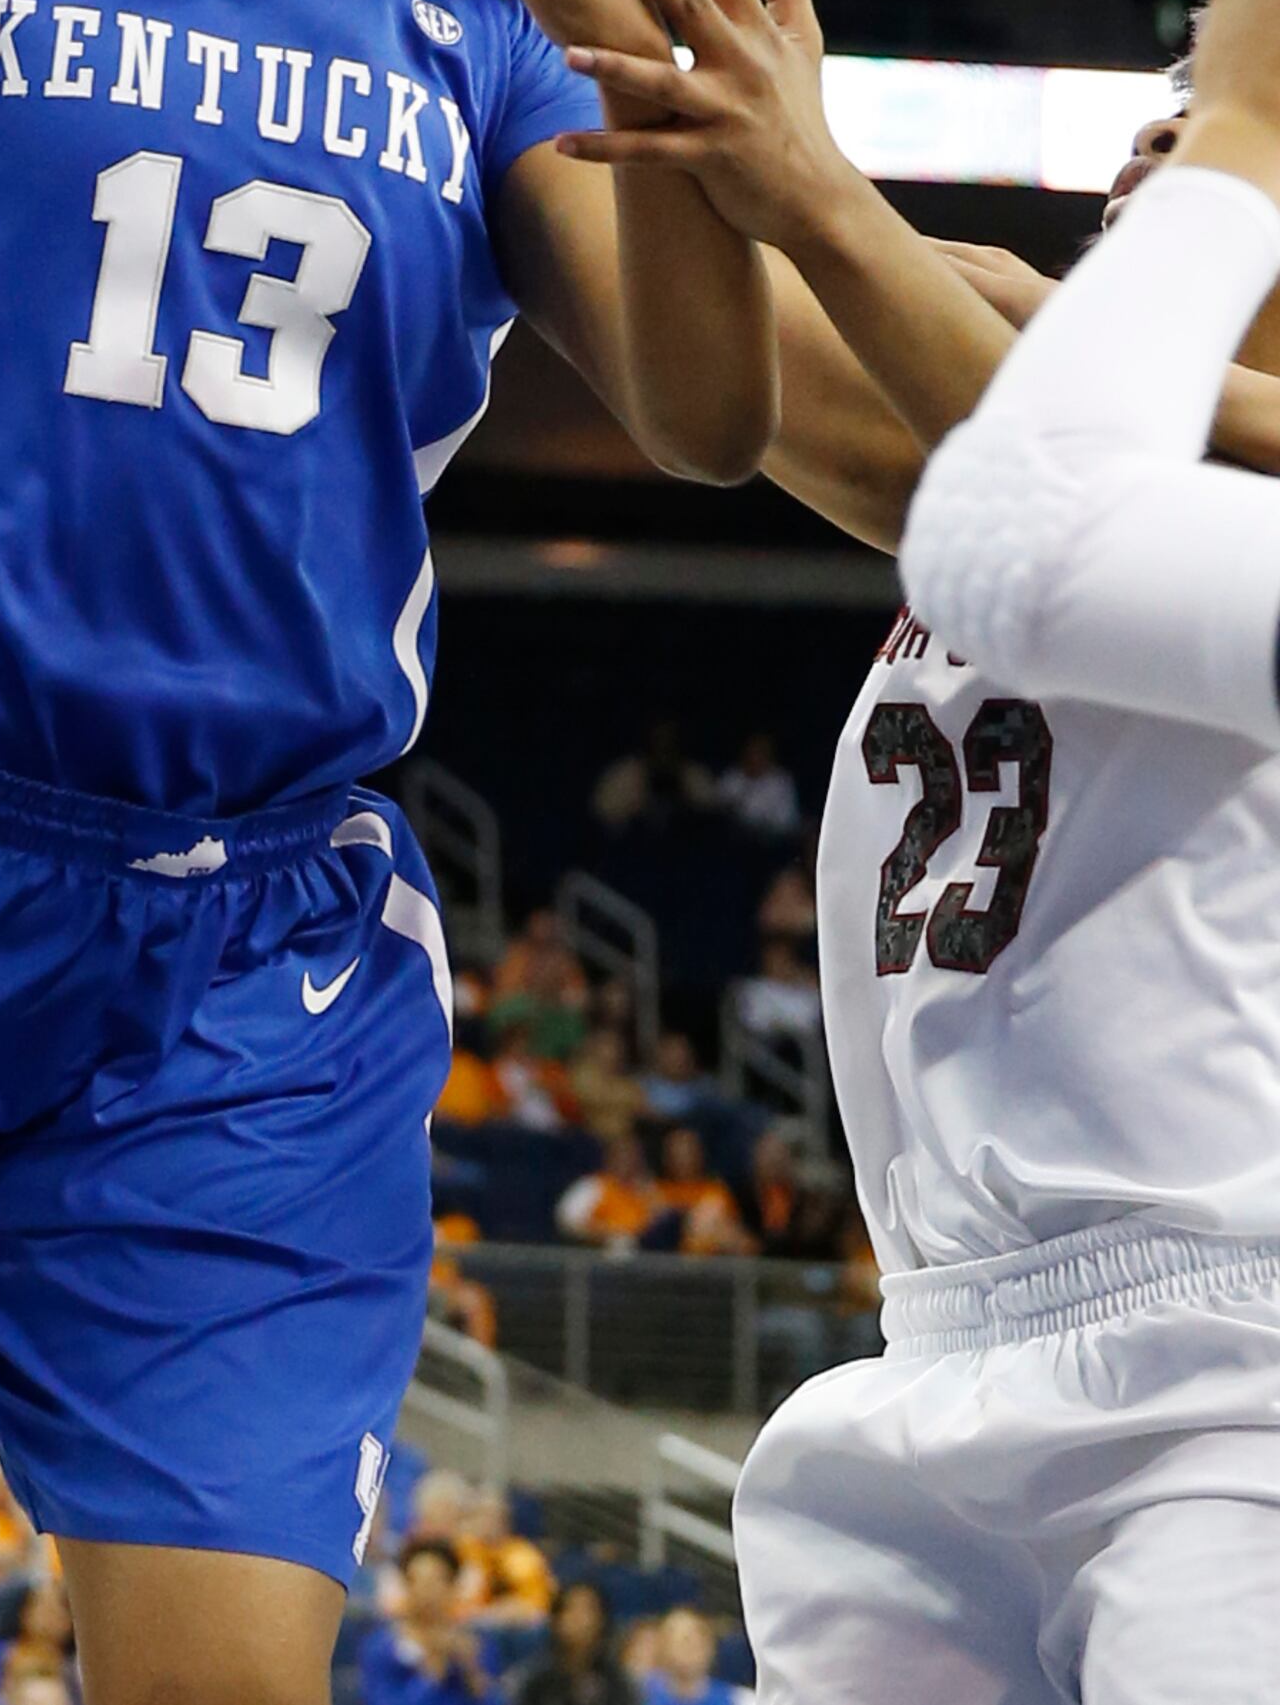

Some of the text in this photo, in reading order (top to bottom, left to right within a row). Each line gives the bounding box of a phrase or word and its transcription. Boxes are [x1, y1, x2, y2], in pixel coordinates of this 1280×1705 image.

[414, 0, 460, 42] SEC
[63, 151, 372, 436] 13
[862, 699, 1053, 976] 23
